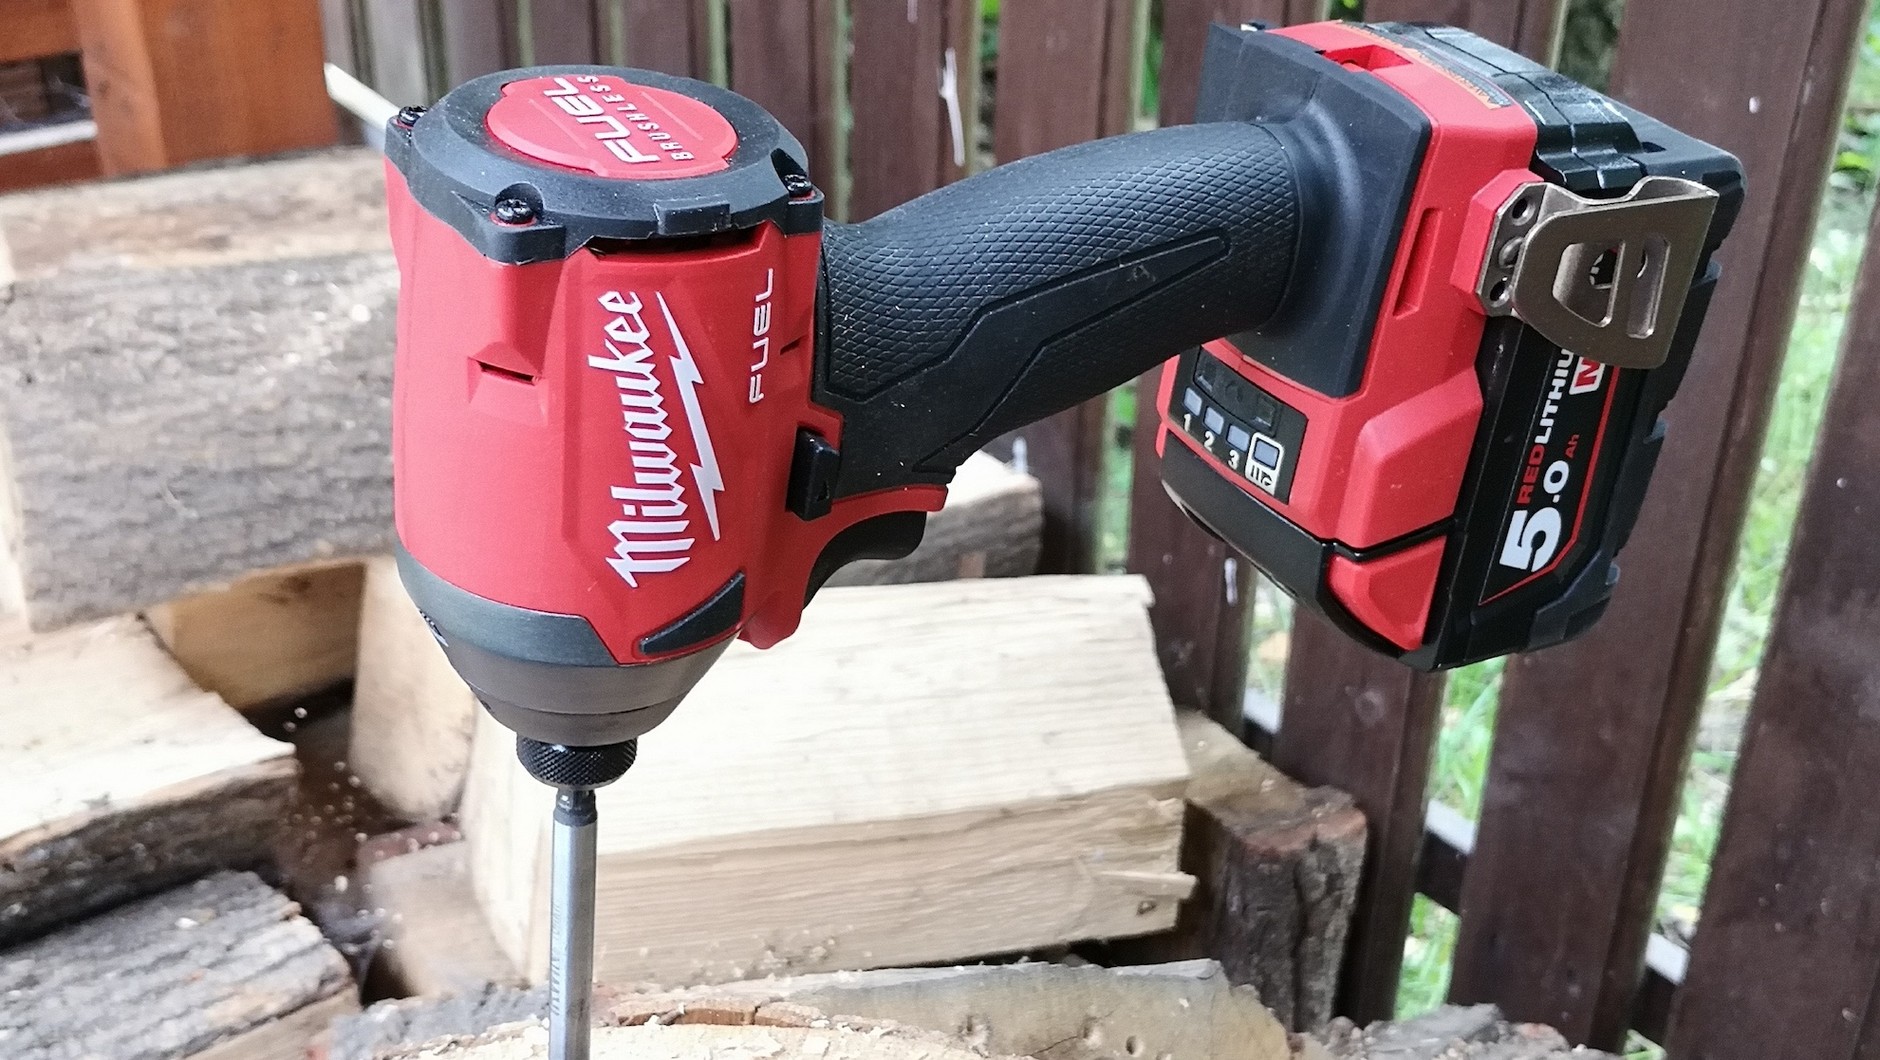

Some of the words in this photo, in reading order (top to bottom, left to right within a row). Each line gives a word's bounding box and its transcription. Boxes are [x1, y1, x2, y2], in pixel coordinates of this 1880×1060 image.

[543, 77, 661, 164] FUEL
[576, 74, 695, 162] BRUSHLESS
[748, 267, 774, 405] FUEL
[586, 290, 696, 589] Milwaukee
[1183, 412, 1192, 433] 1
[1203, 430, 1216, 453] 2
[1227, 449, 1241, 471] 3
[1499, 459, 1570, 573] 5.0
[1564, 433, 1581, 460] Ah
